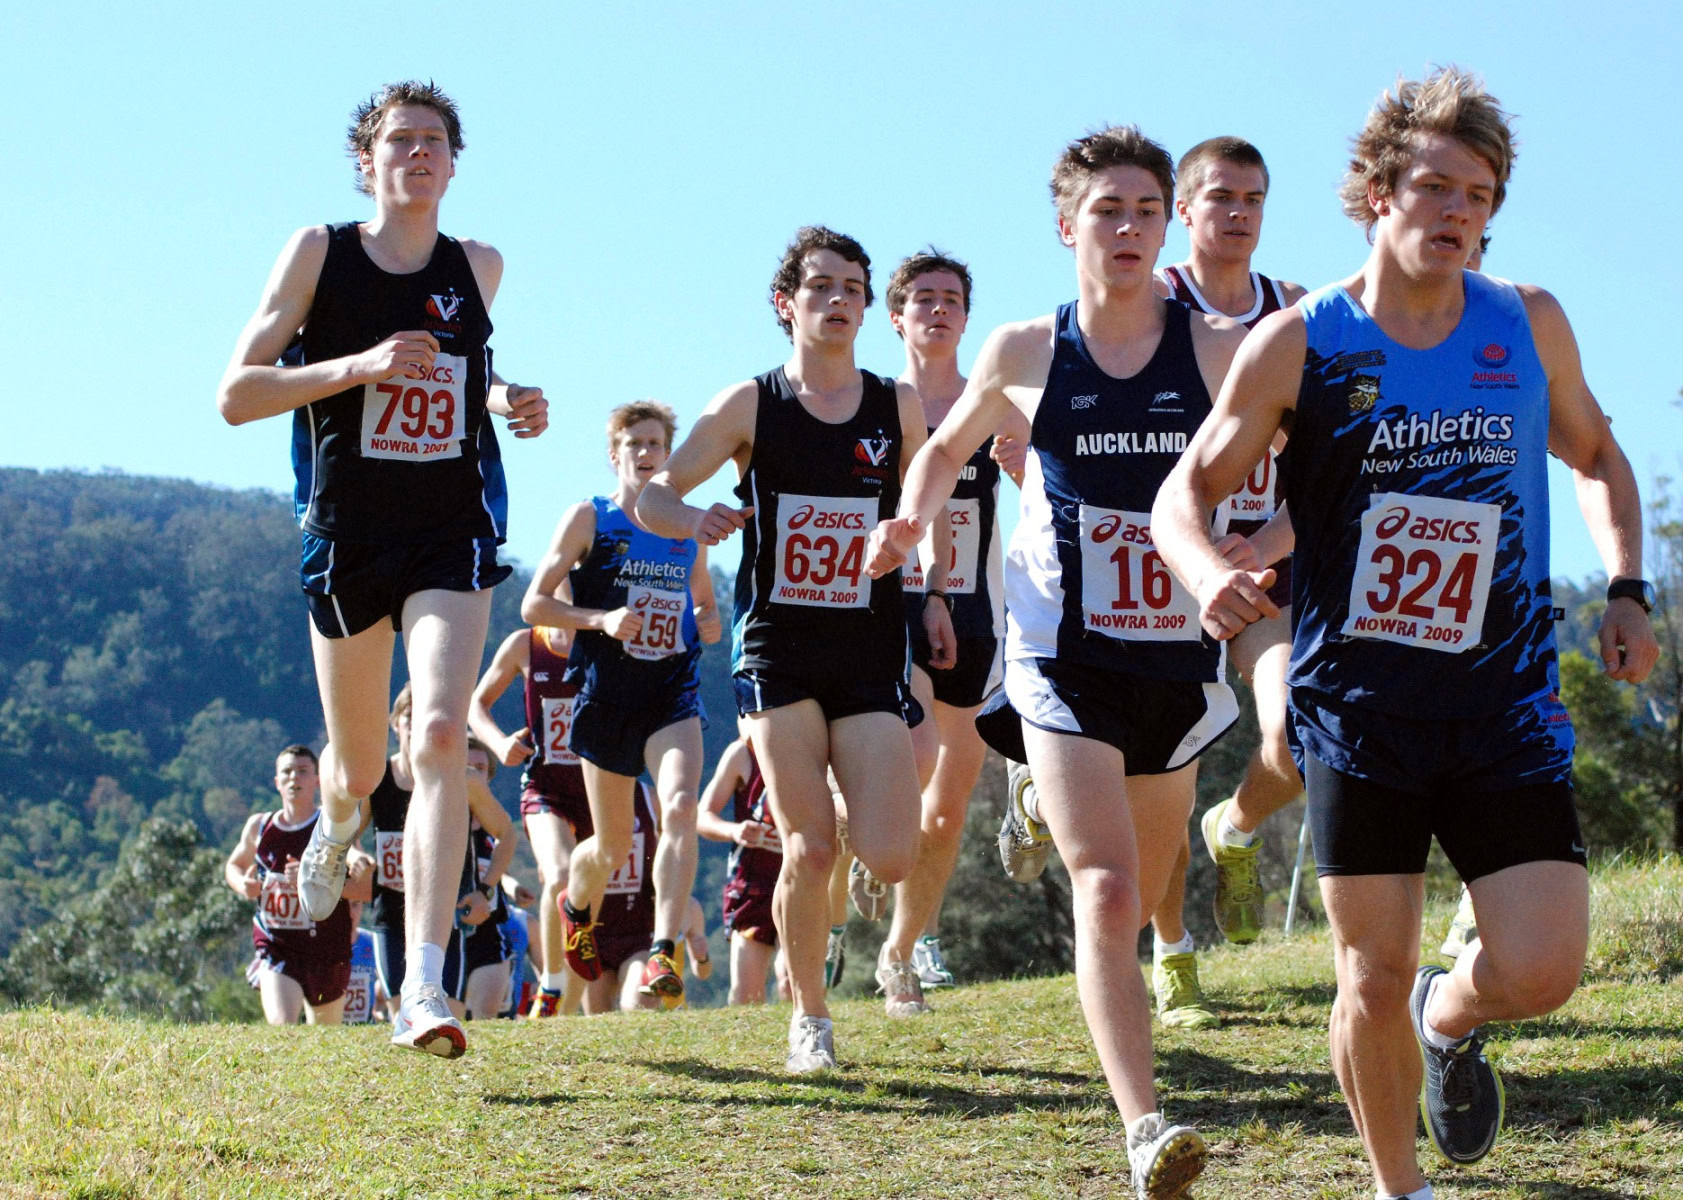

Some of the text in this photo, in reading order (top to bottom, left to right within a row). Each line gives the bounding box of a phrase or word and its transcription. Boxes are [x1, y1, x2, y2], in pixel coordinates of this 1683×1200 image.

[404, 363, 455, 384] sics
[374, 383, 455, 439] 793
[1367, 408, 1513, 454] Athletics
[371, 438, 418, 453] NOWRA
[1075, 432, 1188, 456] AUCKLAND
[1360, 445, 1517, 475] New South Wales
[619, 559, 686, 579] Athletics
[784, 533, 865, 587] 634
[947, 577, 965, 588] 009
[1110, 546, 1172, 610] 16
[1366, 544, 1479, 624] 324
[779, 586, 858, 603] NOWRA 2009
[630, 611, 678, 650] 159
[1090, 613, 1186, 629] NOWRA 2009
[1354, 616, 1464, 644] NOWRA 2009
[265, 893, 300, 918] 407
[345, 988, 366, 1011] 25
